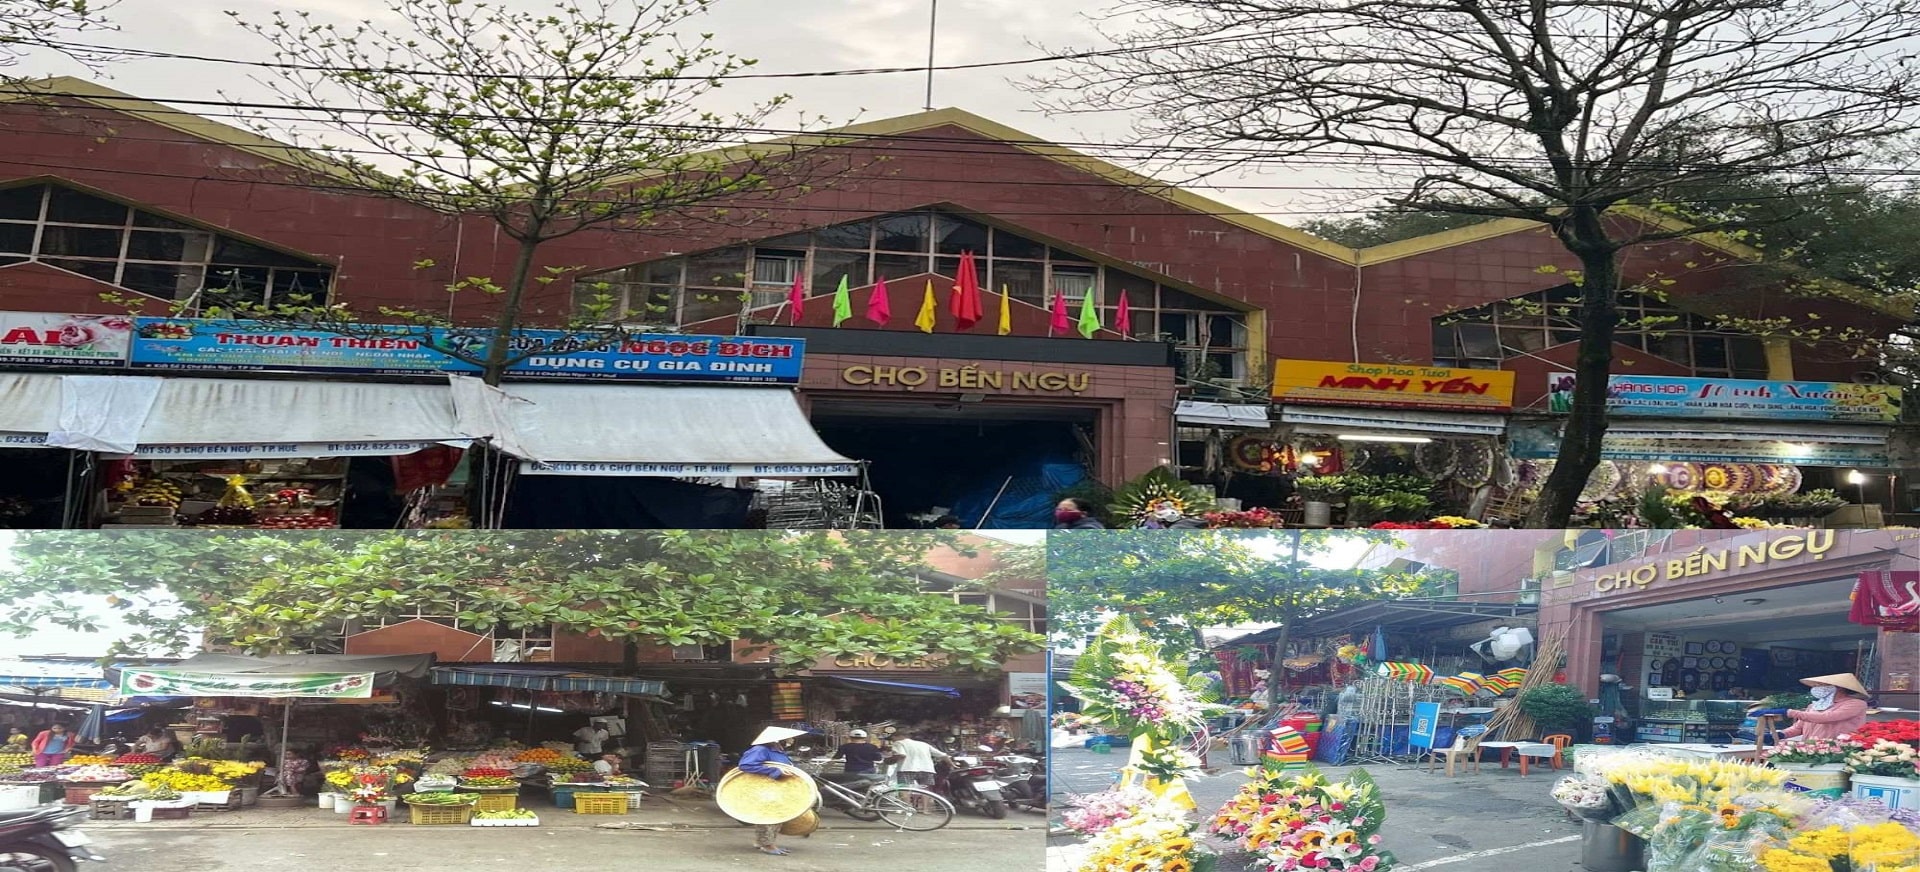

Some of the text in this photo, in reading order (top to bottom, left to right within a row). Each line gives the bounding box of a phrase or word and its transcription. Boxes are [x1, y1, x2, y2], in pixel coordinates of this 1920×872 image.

[717, 341, 793, 358] BÍCH
[529, 356, 772, 373] DỤNG CỤ GIA ĐÌNH
[1347, 365, 1383, 377] Shop
[1387, 367, 1415, 377] Hoa
[843, 365, 928, 391] CHỢ
[938, 361, 1002, 389] BẾN
[1318, 375, 1490, 395] MINH YẾN
[1612, 381, 1653, 394] HÀNG
[1656, 383, 1689, 394] HOA
[1595, 562, 1656, 592] CHỢ
[1666, 545, 1728, 581] BẾN
